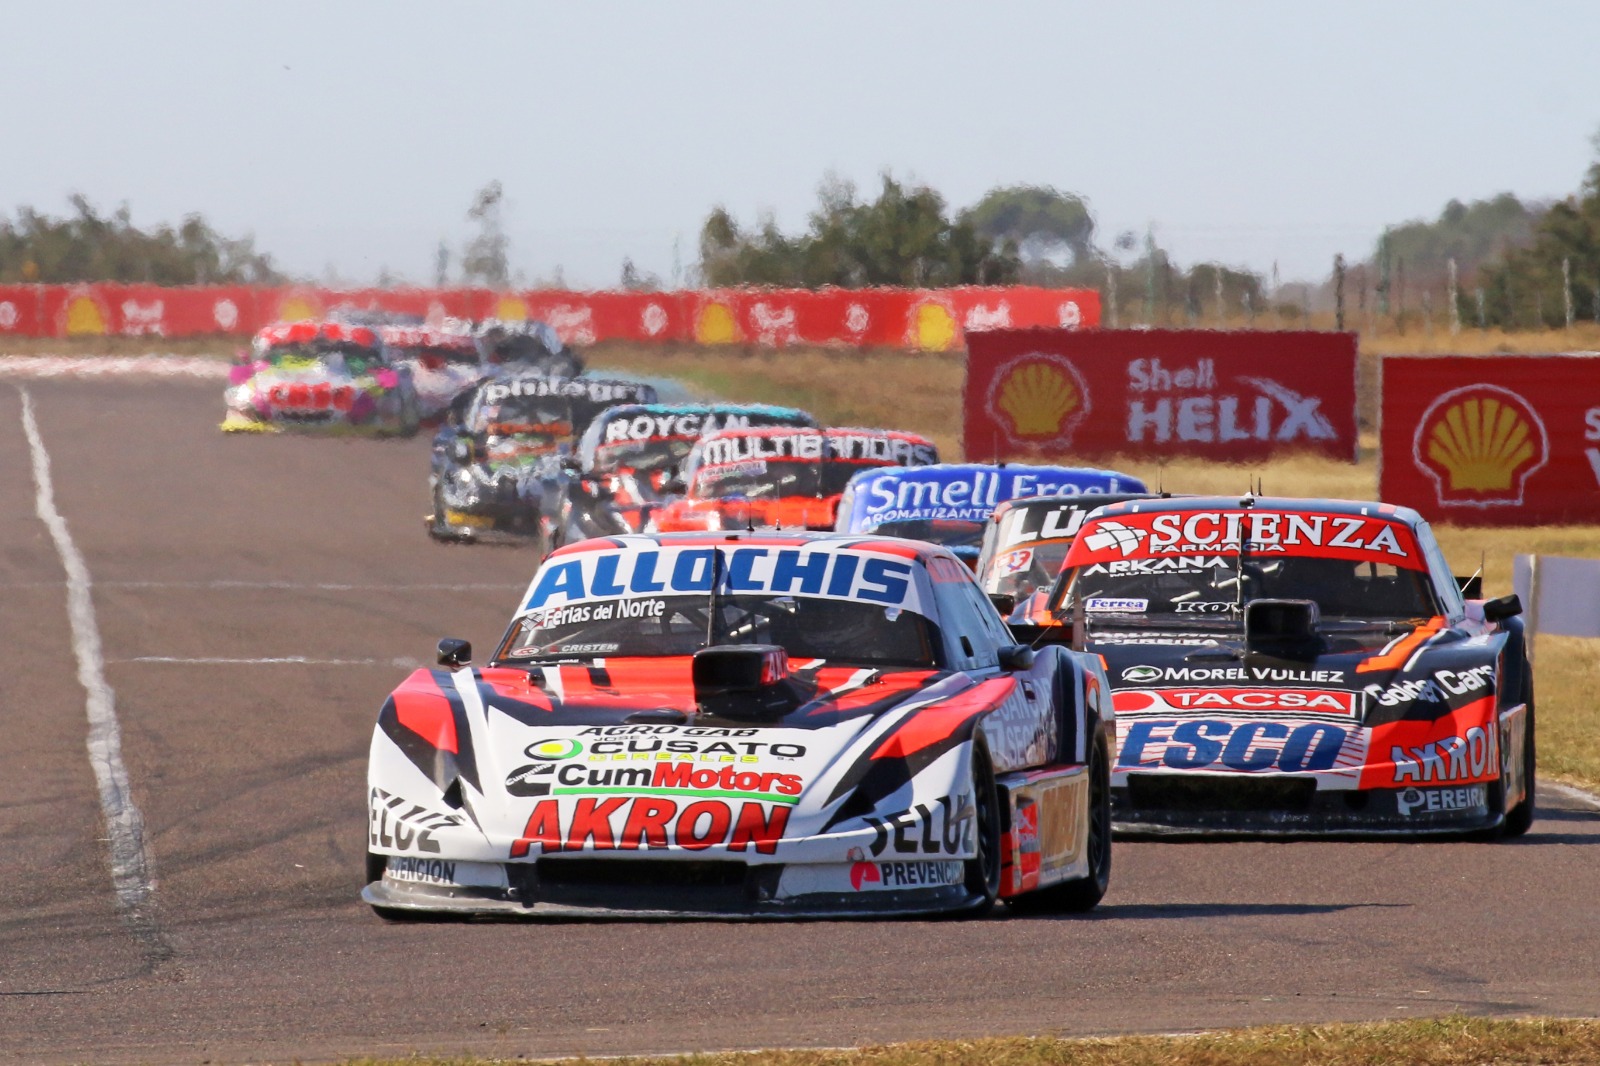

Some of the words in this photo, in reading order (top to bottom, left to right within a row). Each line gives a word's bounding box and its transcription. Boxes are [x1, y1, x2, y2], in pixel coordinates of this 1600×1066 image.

[1127, 358, 1216, 391] Shell
[1127, 376, 1338, 442] HELIX
[867, 471, 999, 514] Smell
[1149, 512, 1407, 557] SCIENZA
[1150, 542, 1285, 554] FARMACIA
[524, 548, 913, 611] ALLOCHIS
[1083, 555, 1229, 577] ARKANA
[543, 605, 591, 628] Ferias
[593, 604, 614, 621] del
[616, 598, 666, 619] Norte
[1090, 599, 1145, 608] Ferrea
[561, 643, 619, 653] CRISTEM
[1164, 667, 1249, 682] MOREL
[1252, 667, 1344, 683] VULLIEZ
[1434, 665, 1497, 696] Cars
[1173, 692, 1347, 711] TACSA
[577, 725, 679, 737] AGRO
[682, 727, 760, 737] GAB
[1117, 719, 1348, 773] ESCO
[588, 752, 760, 764] CEREALES
[590, 739, 807, 758] CUSATO
[1390, 721, 1499, 783] AKRON
[557, 761, 803, 796] CumMotors
[508, 797, 794, 859] AKRON
